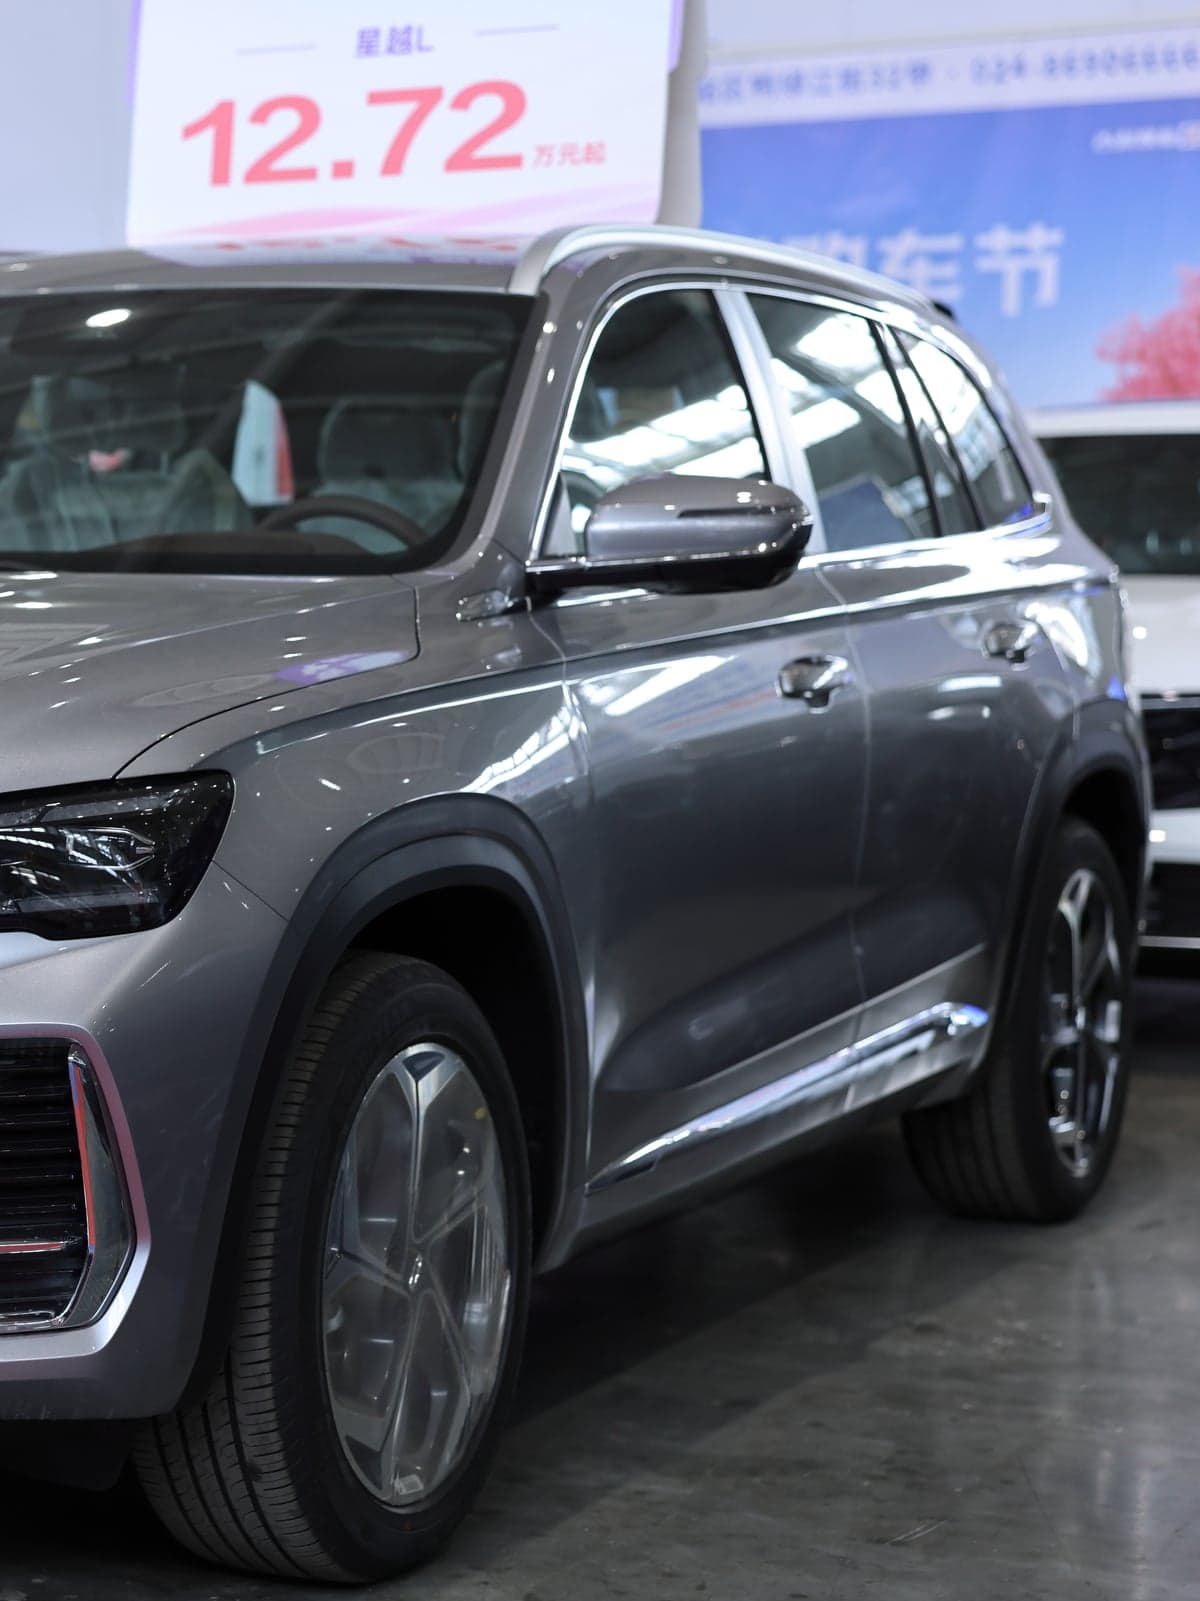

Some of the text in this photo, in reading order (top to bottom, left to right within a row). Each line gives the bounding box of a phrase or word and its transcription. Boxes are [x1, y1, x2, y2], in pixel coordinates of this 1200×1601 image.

[355, 25, 435, 58] 星越L
[181, 79, 607, 187] 12.72 万元起
